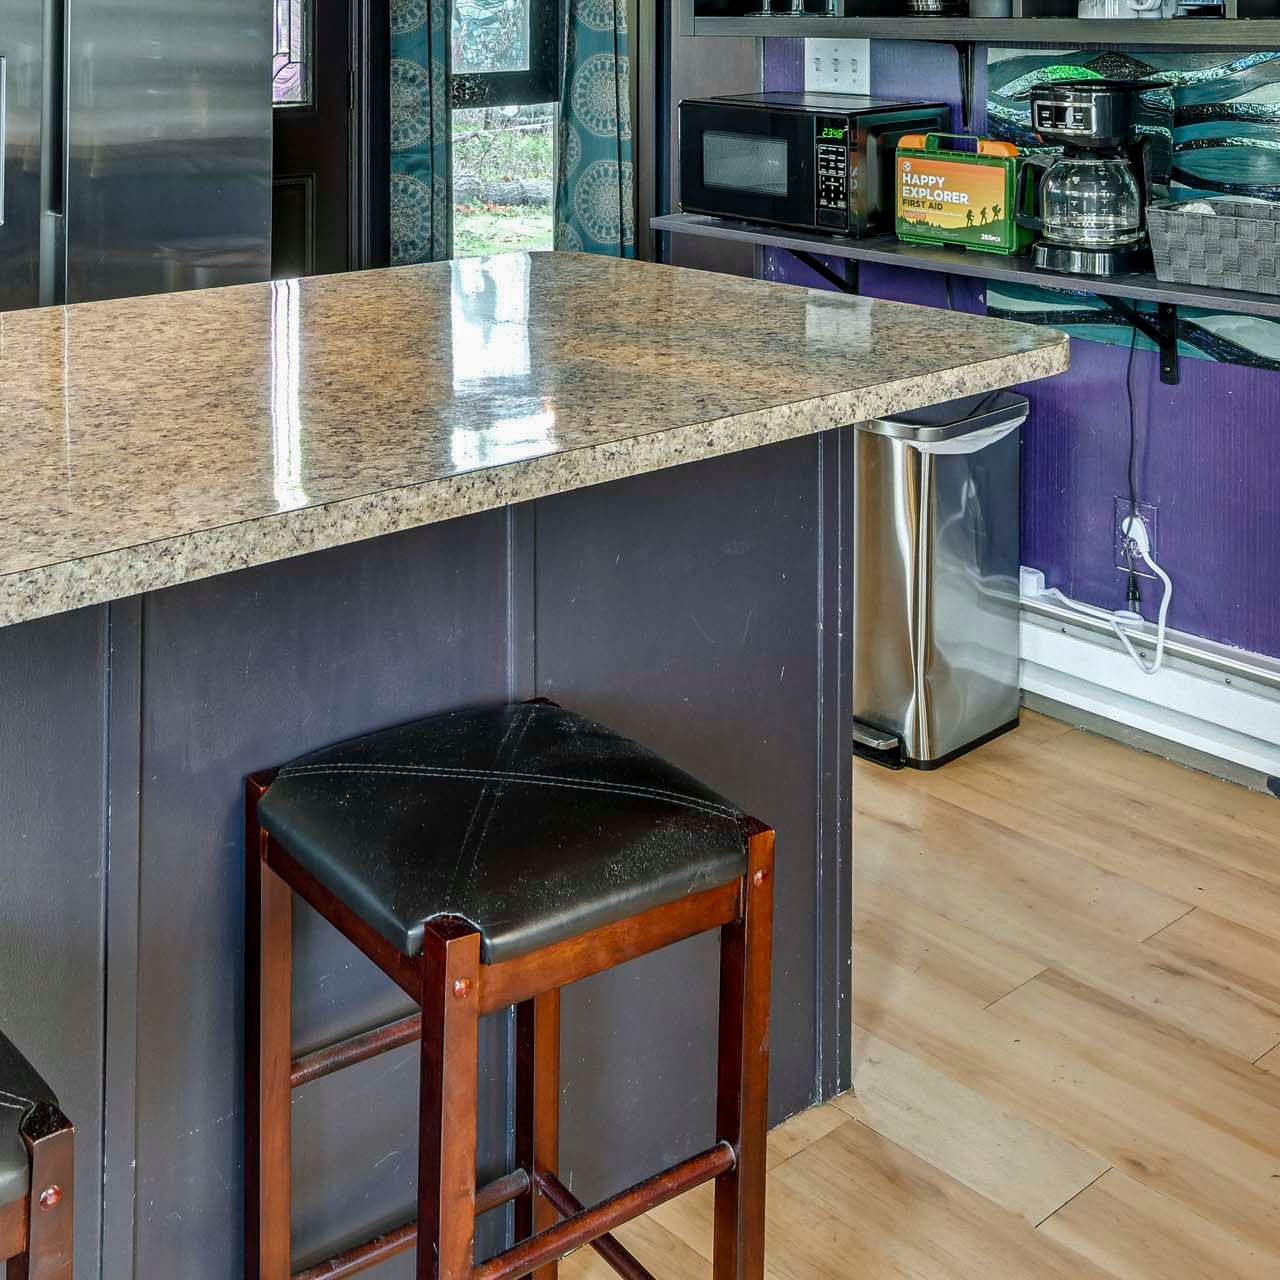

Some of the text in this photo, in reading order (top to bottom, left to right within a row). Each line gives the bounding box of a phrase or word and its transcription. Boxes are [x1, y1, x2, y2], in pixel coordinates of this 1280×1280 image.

[903, 173, 944, 187] HAPPY
[903, 187, 969, 204] EXPLORER
[903, 199, 943, 210] FIRST AID
